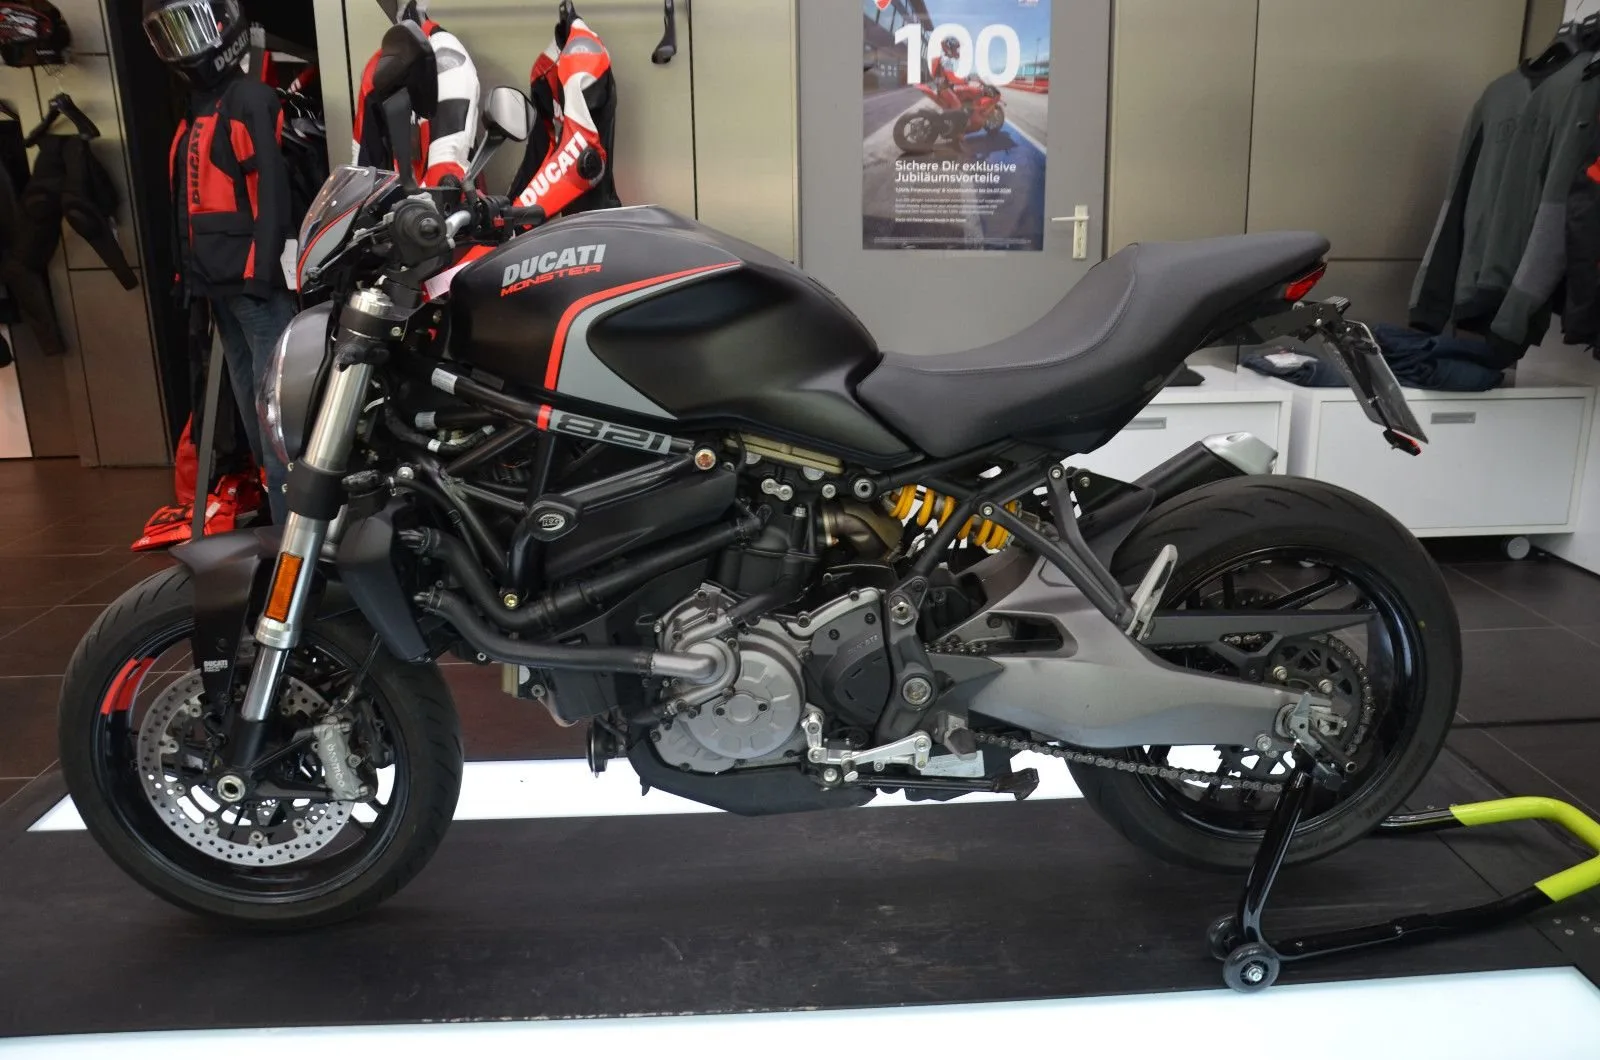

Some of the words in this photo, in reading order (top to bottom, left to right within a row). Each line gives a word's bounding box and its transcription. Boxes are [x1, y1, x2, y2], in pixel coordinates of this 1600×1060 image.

[213, 30, 249, 72] DUCATI
[894, 23, 1020, 86] 100
[190, 122, 204, 204] DUCATI
[519, 131, 588, 207] DUCATI
[895, 160, 939, 171] Sichere
[942, 161, 959, 171] Dir
[962, 161, 1017, 172] exklusive
[895, 171, 1001, 183] Jubiläumsvorteile
[500, 264, 601, 297] MONSTER
[501, 243, 606, 287] DUCATI
[556, 414, 665, 451] 821
[327, 742, 345, 788] brembo
